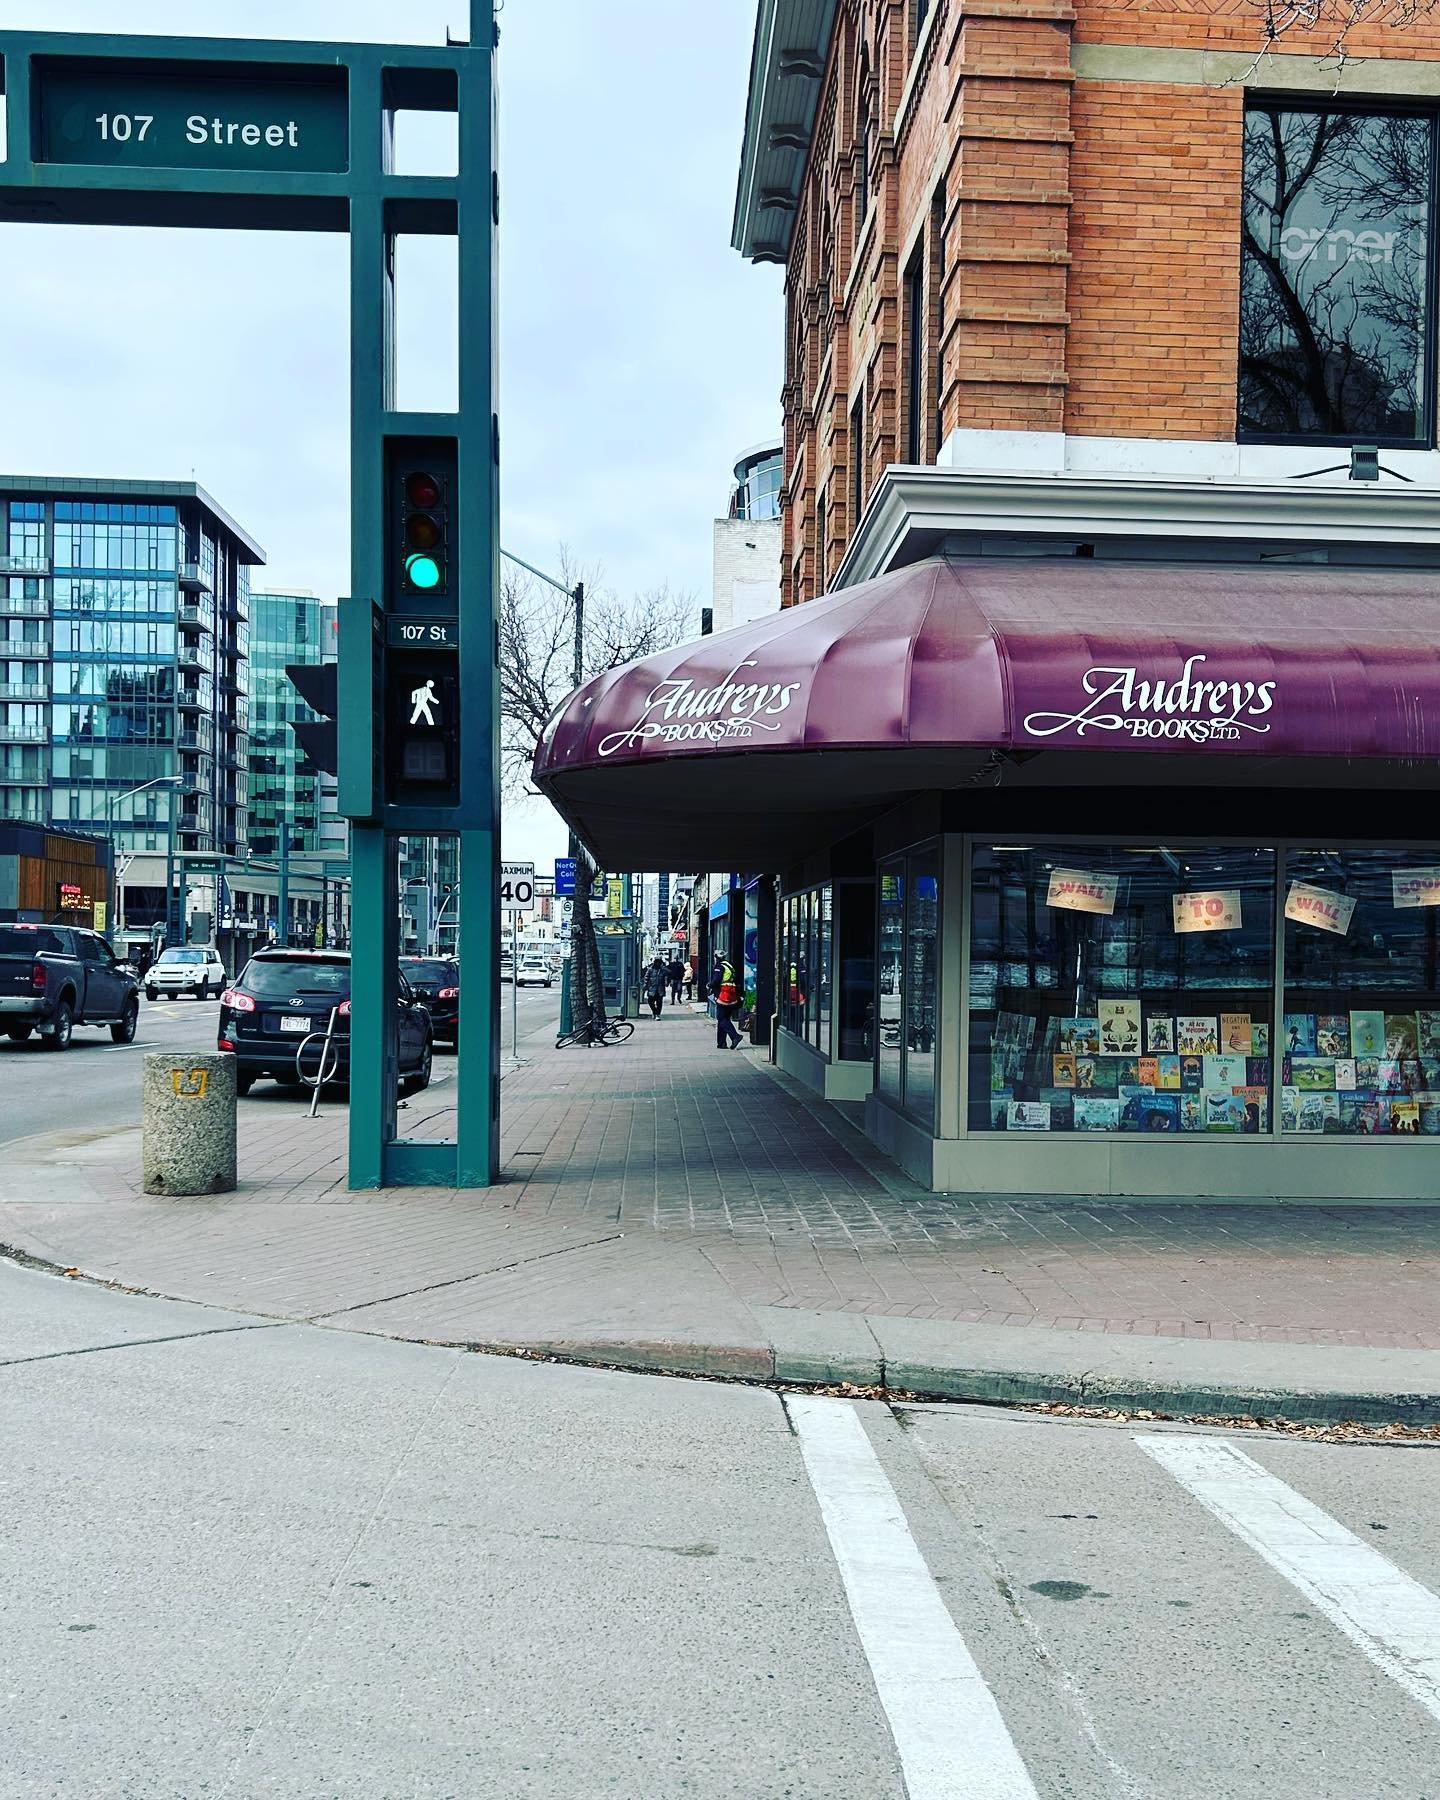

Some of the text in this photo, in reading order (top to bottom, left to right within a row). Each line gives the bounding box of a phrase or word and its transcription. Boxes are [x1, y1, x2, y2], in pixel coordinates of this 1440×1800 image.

[95, 113, 299, 147] 107 Street
[400, 625, 447, 641] 107 St
[1023, 654, 1278, 737] Audreys
[597, 660, 801, 757] Audreys
[659, 719, 727, 743] BOOKS
[1123, 719, 1211, 744] BOOKS
[500, 881, 533, 902] 40
[1058, 880, 1105, 900] WALL
[1189, 897, 1224, 918] TO
[1295, 896, 1340, 921] WALL
[1222, 1016, 1250, 1024] NEGATIVE
